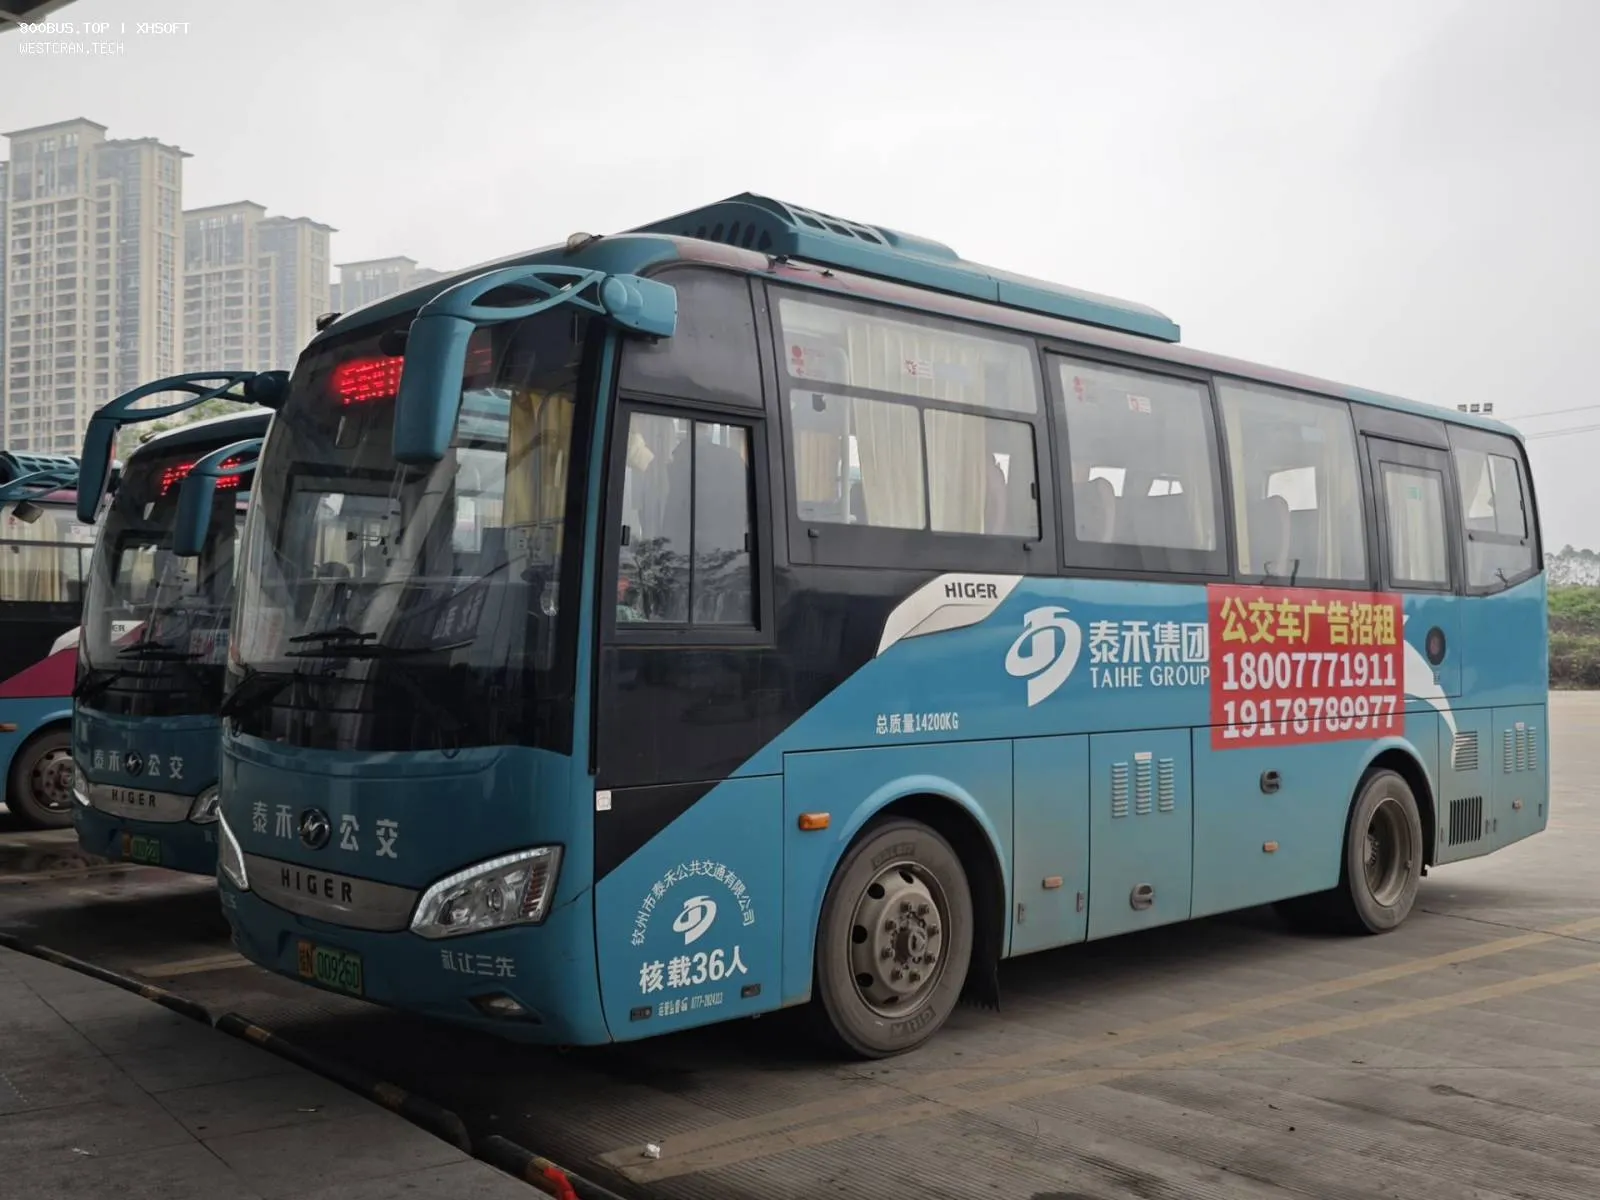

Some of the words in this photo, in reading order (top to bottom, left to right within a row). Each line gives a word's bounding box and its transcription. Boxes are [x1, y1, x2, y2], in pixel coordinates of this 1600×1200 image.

[944, 582, 998, 599] HIGER
[1220, 596, 1397, 645] 公交车广告招租
[1089, 619, 1209, 664] 泰禾集团
[1090, 667, 1143, 688] TAIHE
[1151, 665, 1211, 687] GROUP
[1222, 651, 1397, 691] 18007771911
[875, 712, 960, 735] 总质量14200KG
[1223, 695, 1398, 739] 19178789977
[111, 787, 157, 808] HIGER
[281, 867, 354, 904] HIGER
[631, 859, 756, 947] 钦州市泰禾公共交通有限公司
[639, 945, 748, 994] 核载36人
